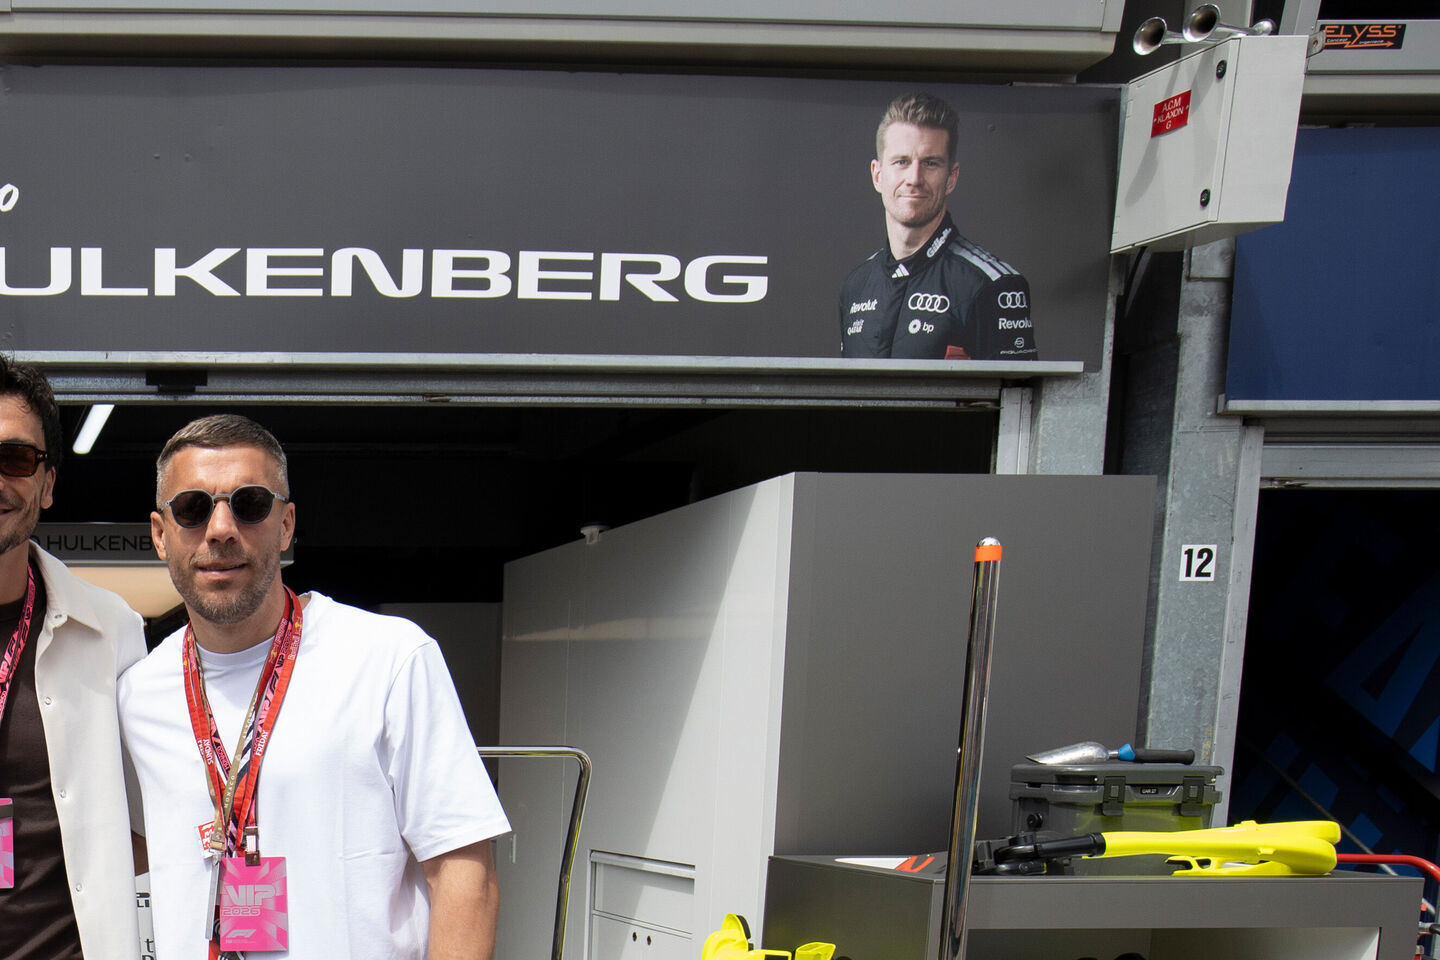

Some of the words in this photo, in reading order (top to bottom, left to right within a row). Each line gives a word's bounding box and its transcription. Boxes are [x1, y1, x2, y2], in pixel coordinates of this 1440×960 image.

[1157, 106, 1184, 124] KLAXON
[1165, 120, 1172, 130] G
[849, 299, 878, 315] Revolut
[922, 321, 935, 335] bp
[46, 535, 152, 551] HULKENB
[1184, 548, 1213, 578] 12
[255, 731, 269, 757] FRIDAY
[224, 774, 236, 809] MONACO
[224, 884, 276, 906] VIP
[221, 906, 261, 917] 2026
